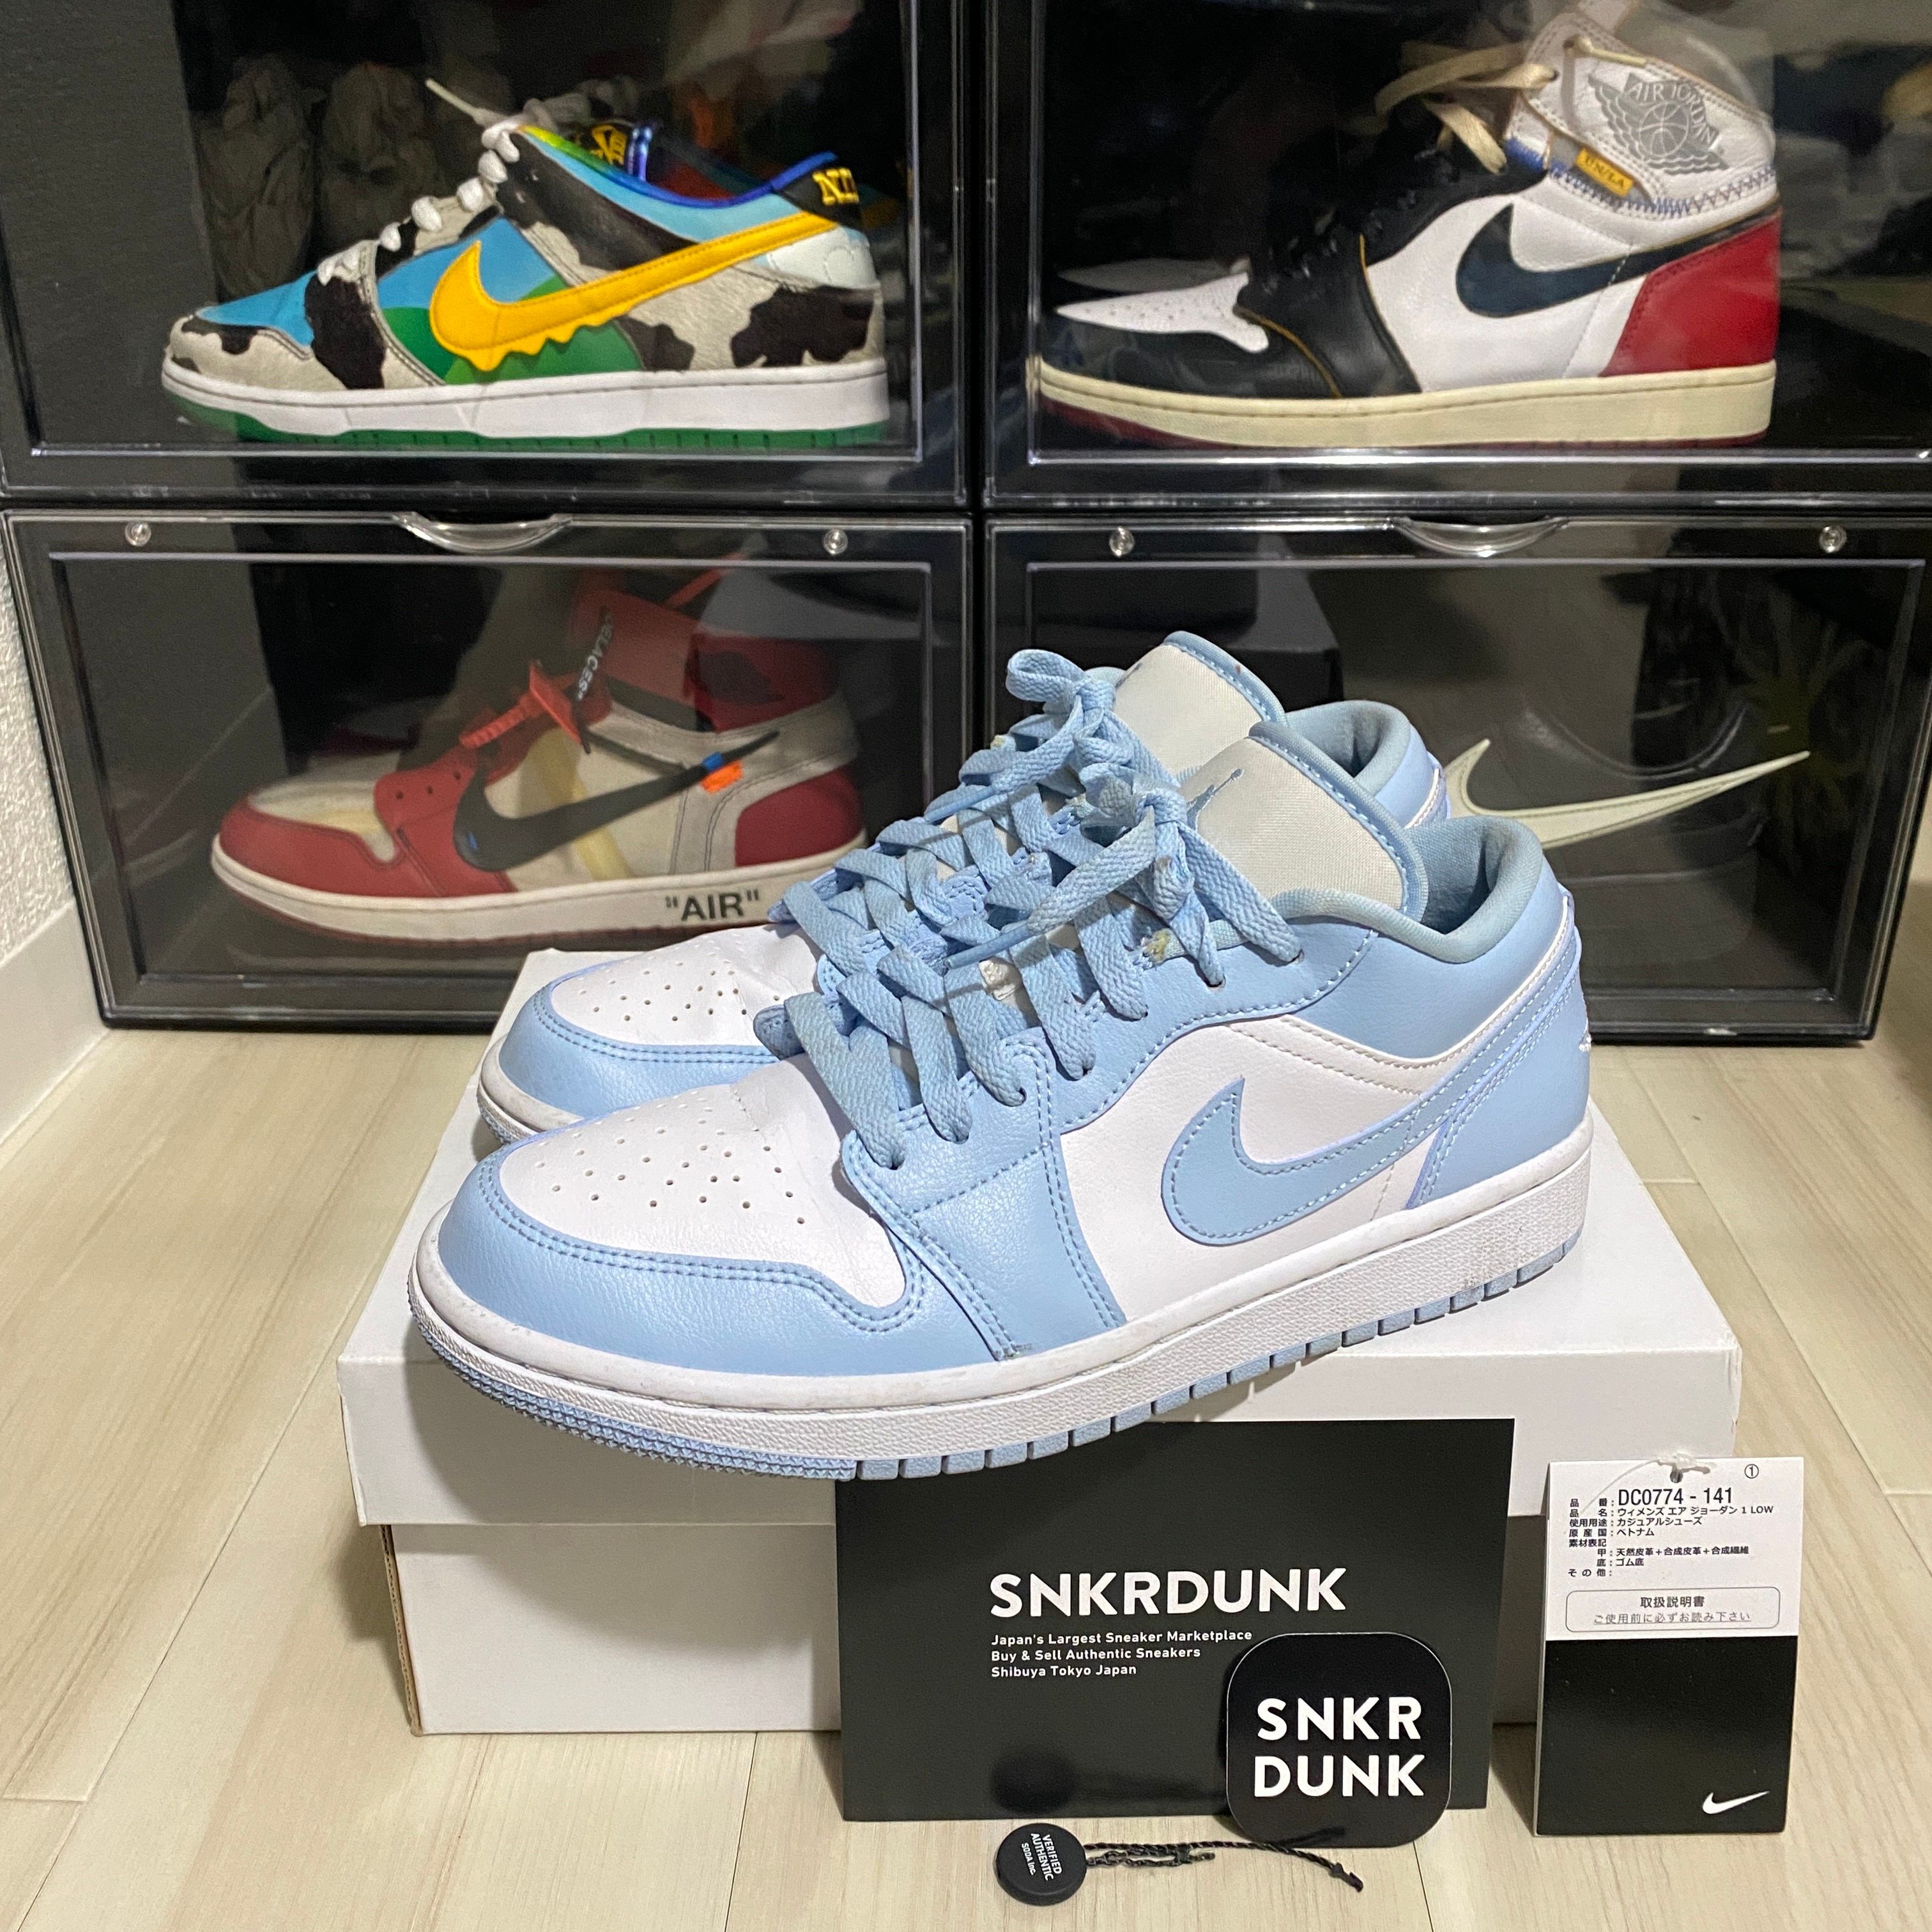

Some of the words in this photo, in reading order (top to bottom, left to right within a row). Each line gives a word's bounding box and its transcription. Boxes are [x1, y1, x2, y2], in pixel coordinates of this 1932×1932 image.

[666, 890, 760, 921] "AIR"
[1618, 1488, 1683, 1506] DC0774
[1703, 1487, 1732, 1504] 141
[1618, 1506, 1665, 1517] ウィメンズ
[1668, 1506, 1686, 1515] エア
[1690, 1505, 1738, 1515] ジョーダン
[1751, 1505, 1774, 1514] LOW
[1616, 1516, 1703, 1527] カジュアルシューズ
[1616, 1528, 1655, 1537] ベトナム
[990, 1567, 1346, 1618] SNKRDUNK
[1640, 1596, 1705, 1608] 取扱説明書
[1593, 1611, 1751, 1624] ご使用前に必ずお読み下さい
[992, 1634, 1044, 1647] Japan's
[1048, 1632, 1101, 1646] Largest
[1105, 1631, 1162, 1643] Sneaker
[1167, 1630, 1252, 1643] Marketplace
[992, 1650, 1017, 1663] Buy
[1022, 1650, 1031, 1660] &
[1035, 1649, 1061, 1660] Sell
[1066, 1648, 1131, 1660] Authentic
[1136, 1646, 1200, 1659] Sneakers
[992, 1666, 1046, 1678] Shibuya
[1050, 1666, 1091, 1678] Tokyo
[1096, 1664, 1137, 1677] Japan
[1257, 1696, 1422, 1741] SNKR
[1254, 1754, 1425, 1797] DUNK
[1022, 1843, 1033, 1863] SODA
[1031, 1833, 1054, 1881] AUTHENTIC
[1042, 1834, 1062, 1874] VERIFIED
